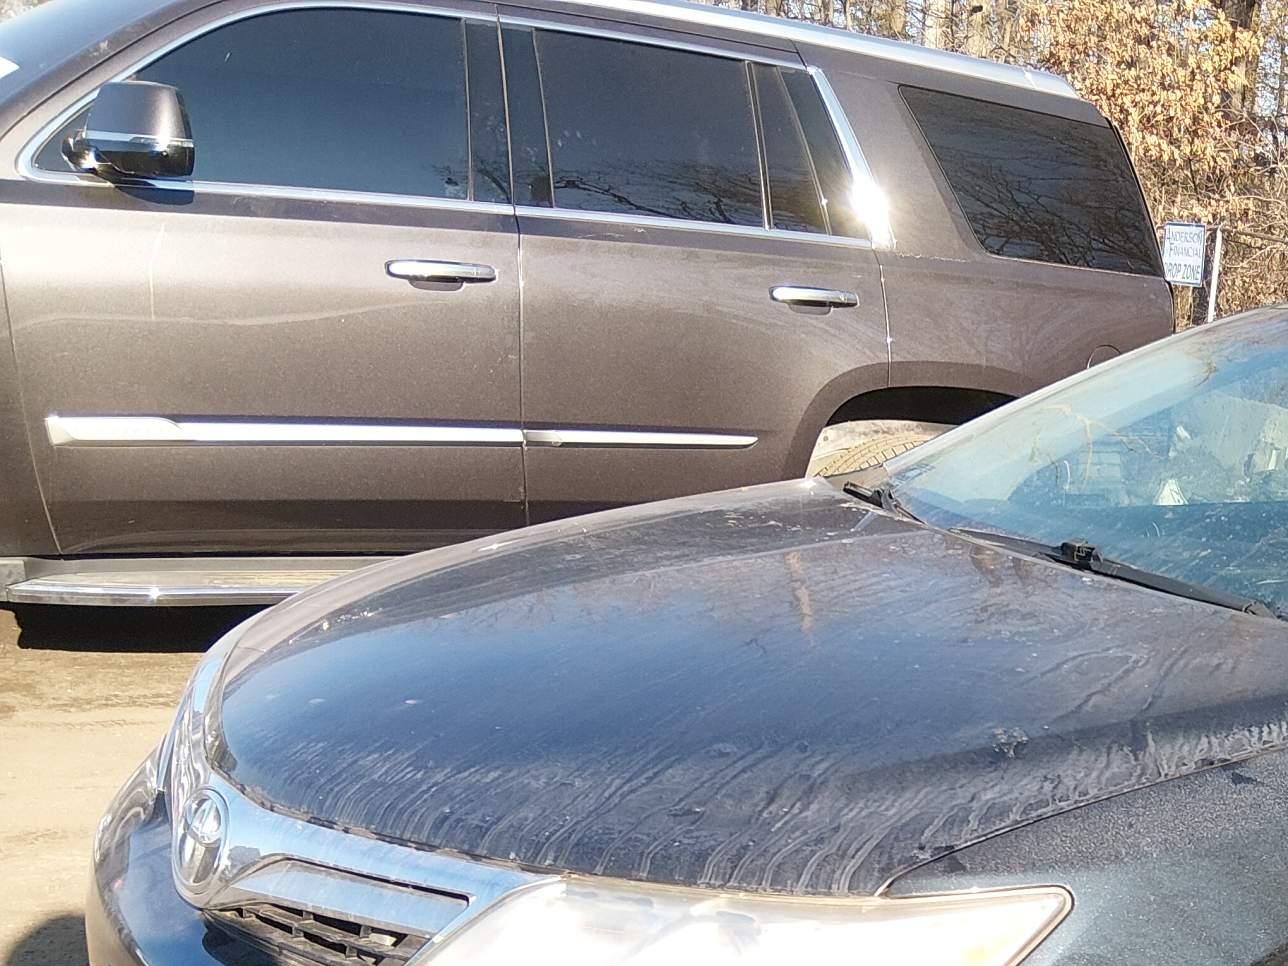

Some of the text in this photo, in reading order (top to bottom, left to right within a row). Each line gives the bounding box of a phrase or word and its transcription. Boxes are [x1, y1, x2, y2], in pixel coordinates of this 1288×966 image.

[1167, 227, 1202, 245] ANDERSON
[1169, 243, 1201, 258] FINANCIAL
[1182, 264, 1200, 280] ZONE
